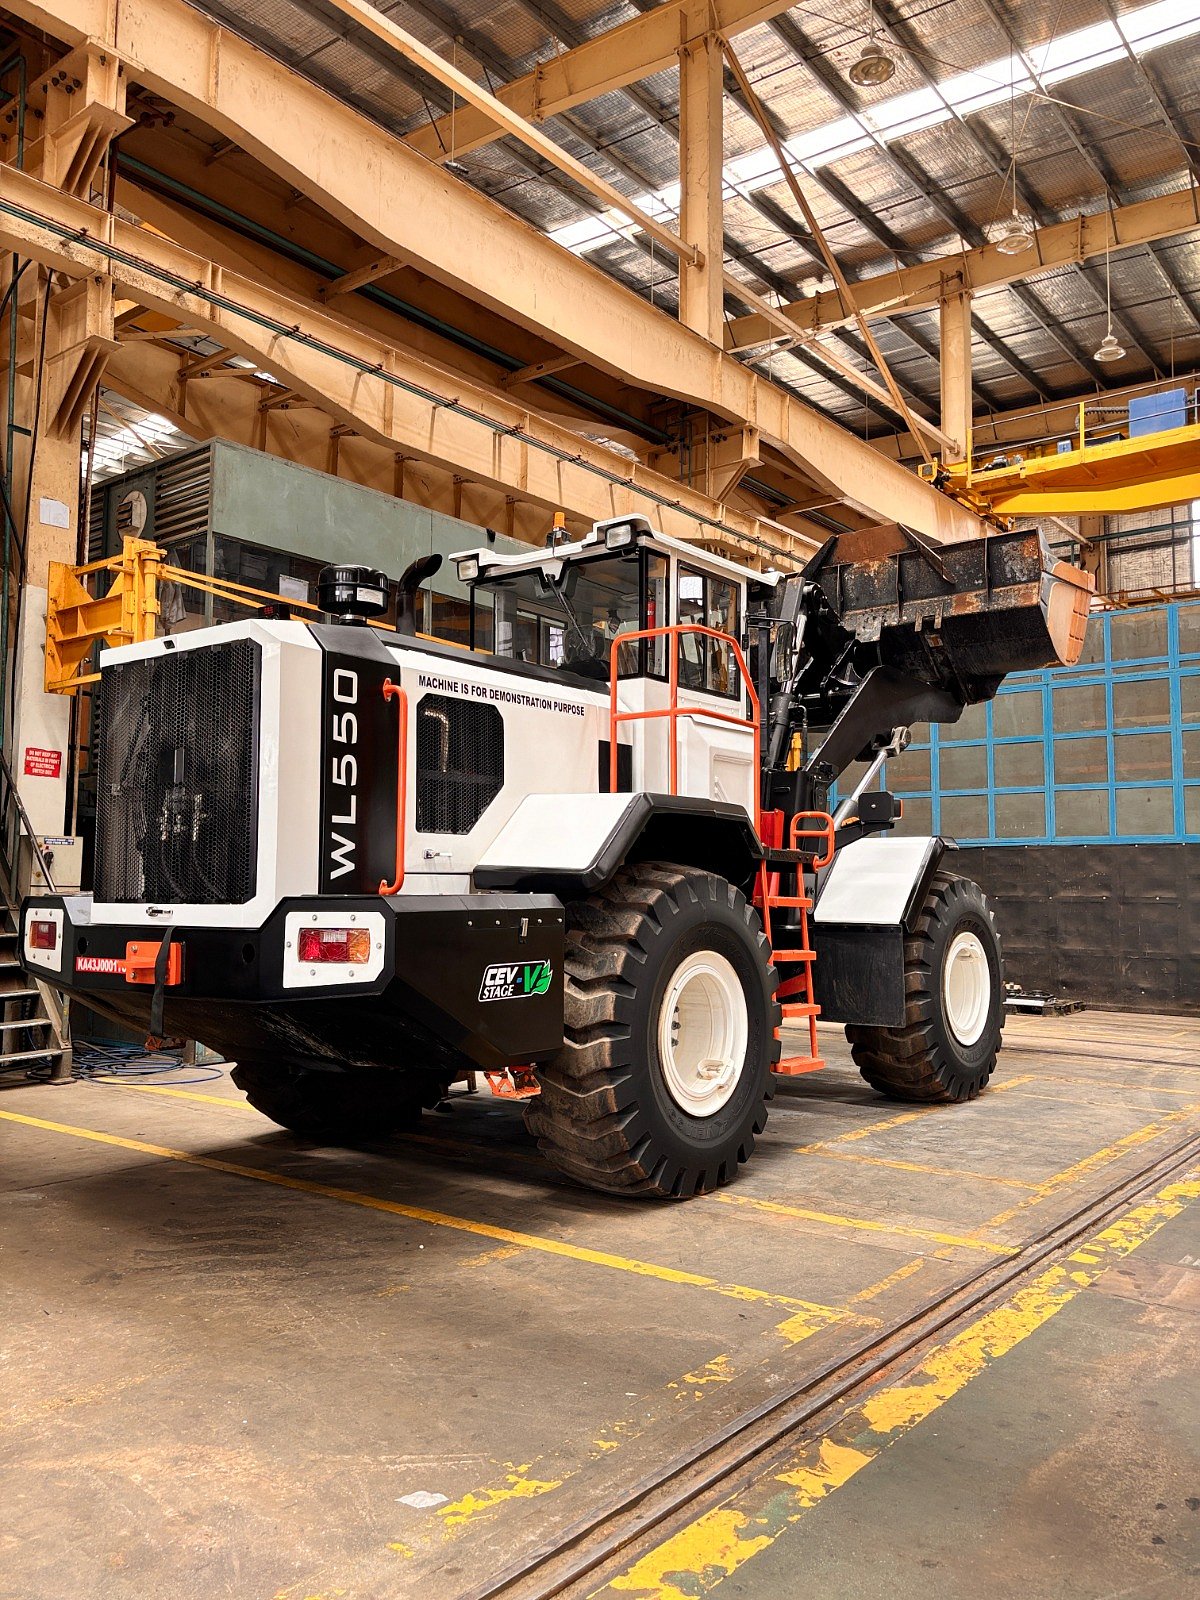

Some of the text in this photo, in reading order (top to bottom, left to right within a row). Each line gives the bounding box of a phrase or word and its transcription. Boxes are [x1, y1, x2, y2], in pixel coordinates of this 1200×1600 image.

[419, 675, 585, 717] MACHINE IS FOR DEMONSTRATION PURPOSE
[330, 668, 358, 880] WL550
[78, 958, 127, 973] KA43J0001
[485, 966, 519, 986] CEV
[482, 984, 515, 999] STAGE
